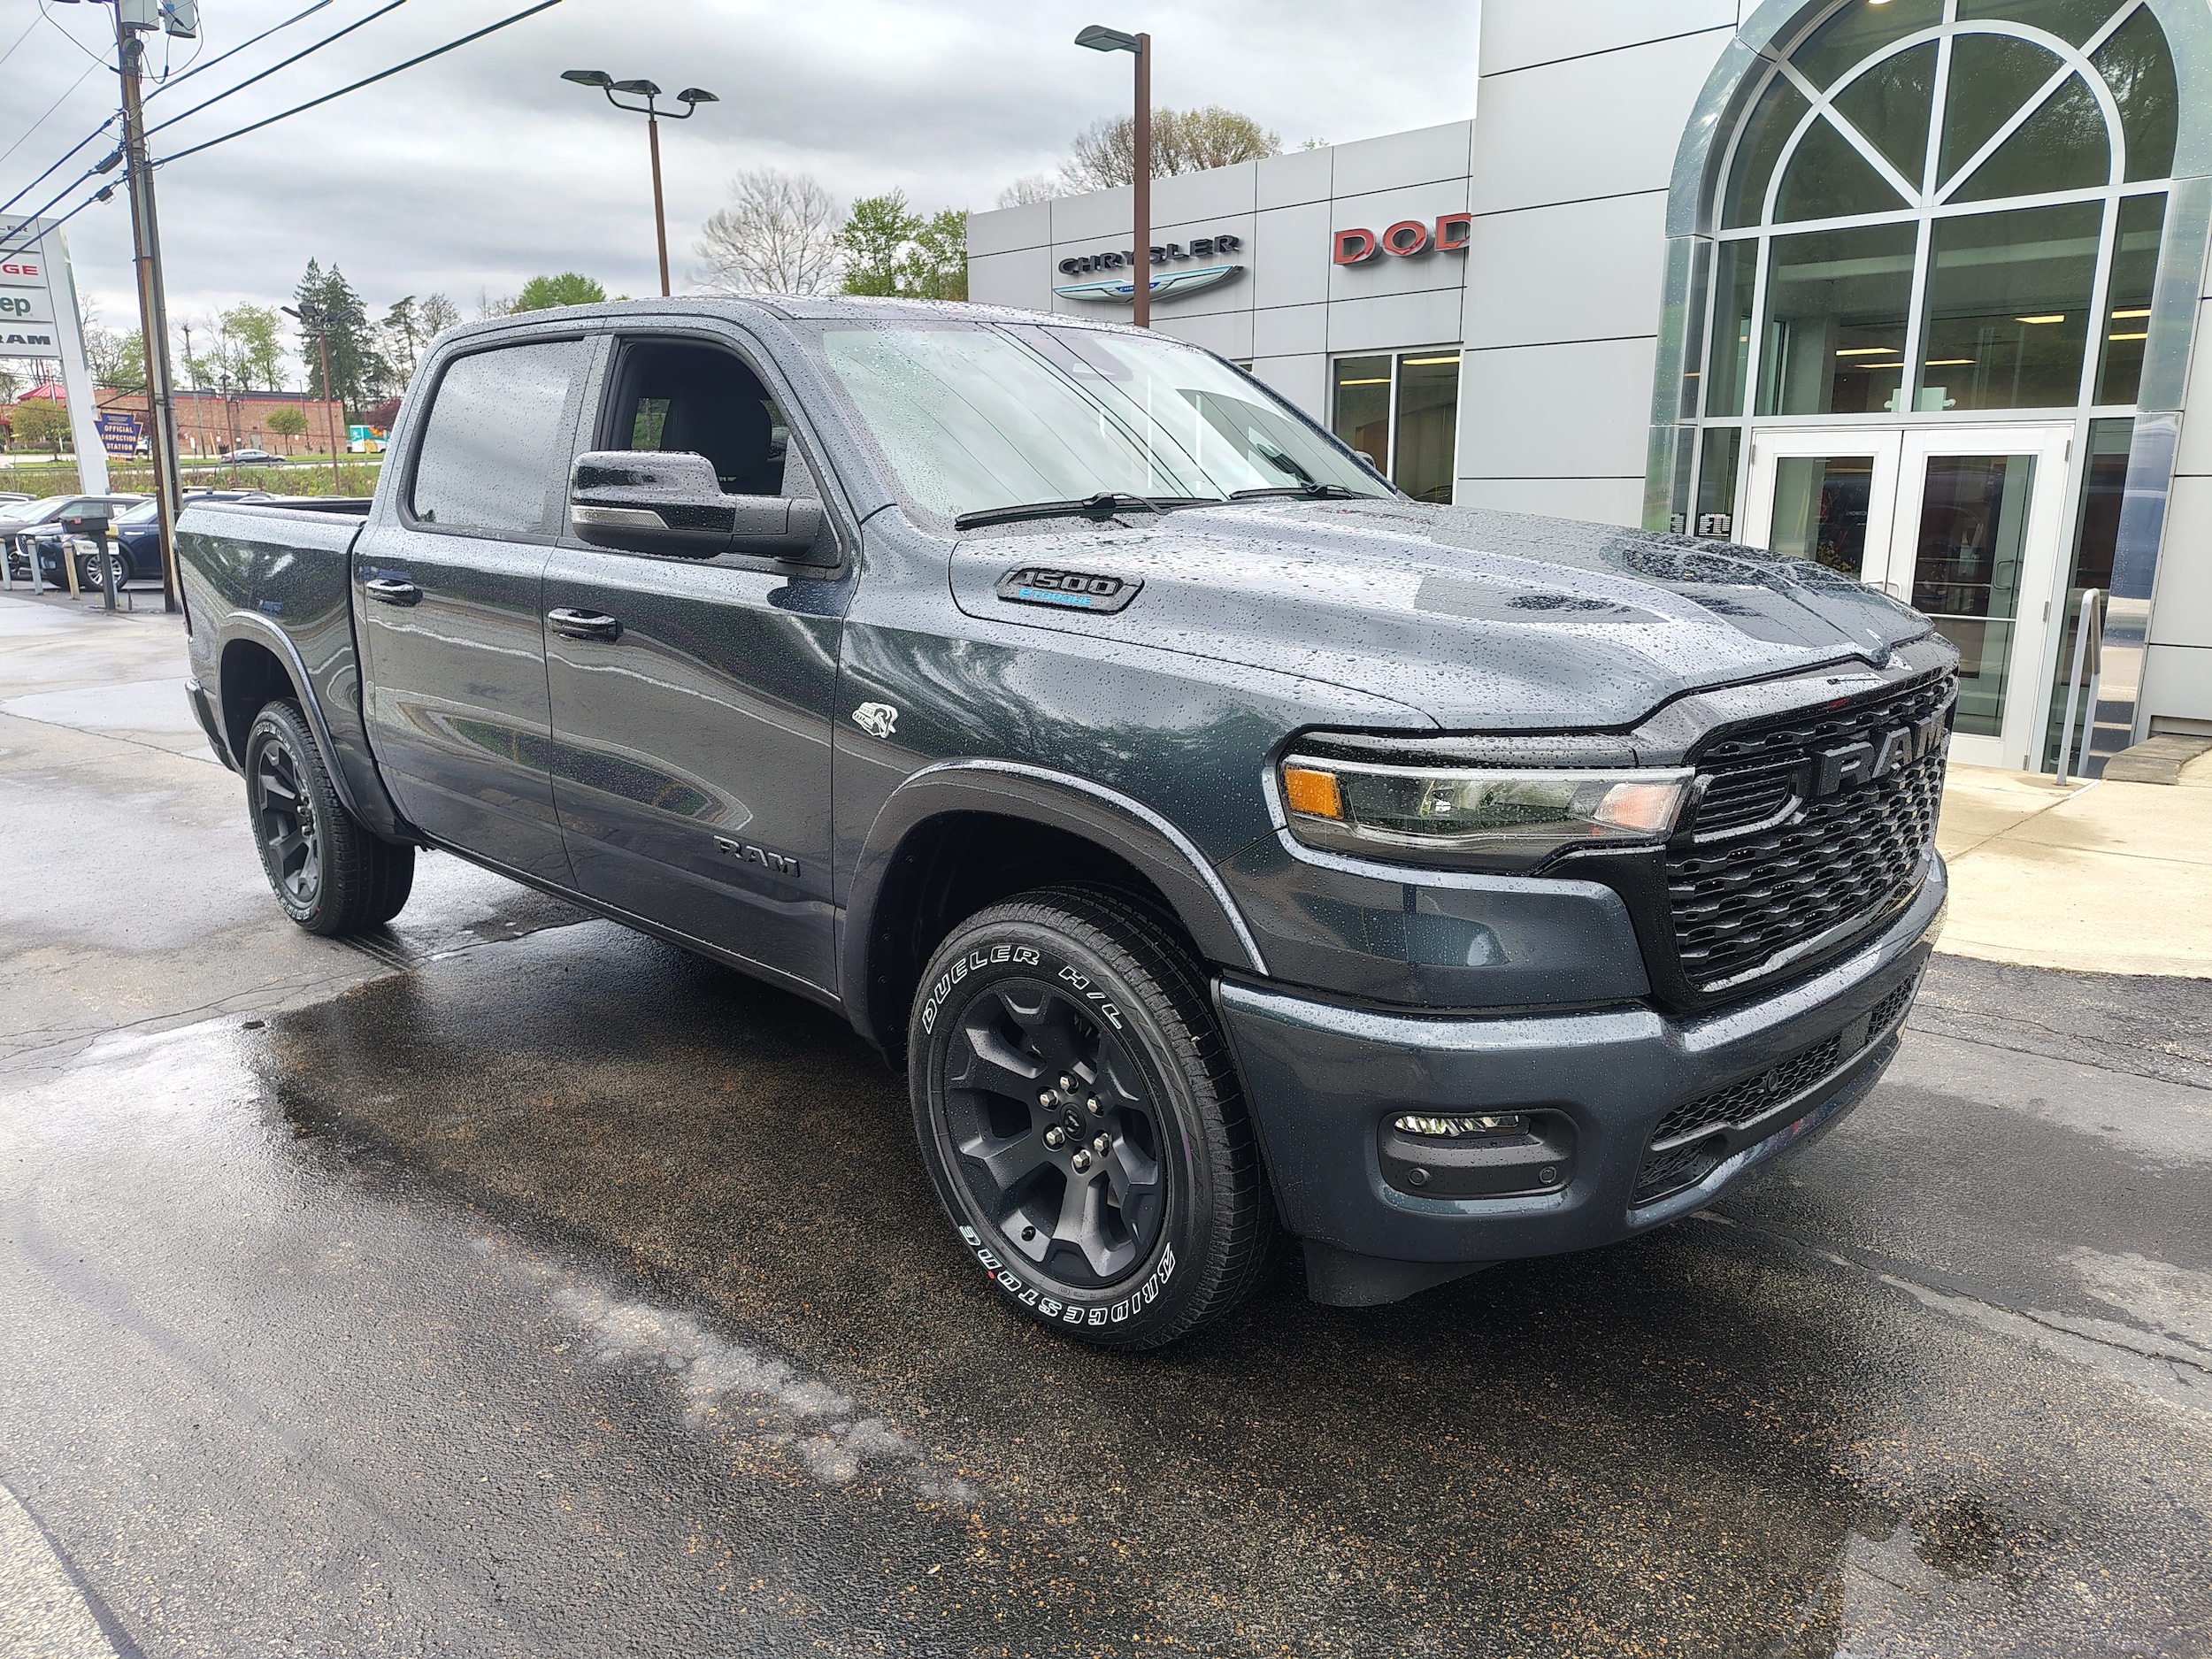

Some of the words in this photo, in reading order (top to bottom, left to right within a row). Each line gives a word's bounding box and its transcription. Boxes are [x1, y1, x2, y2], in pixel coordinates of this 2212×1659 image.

[1058, 234, 1239, 275] CHRYSLER
[101, 434, 137, 442] INSPECTION
[104, 425, 134, 434] OFFICIAL
[106, 442, 133, 451] STATION
[1013, 570, 1118, 595] 1500
[1816, 707, 1947, 796] RAM
[713, 834, 800, 877] RAM
[922, 945, 1040, 1034] DUELER
[958, 1225, 1176, 1325] BRIDGESTONE
